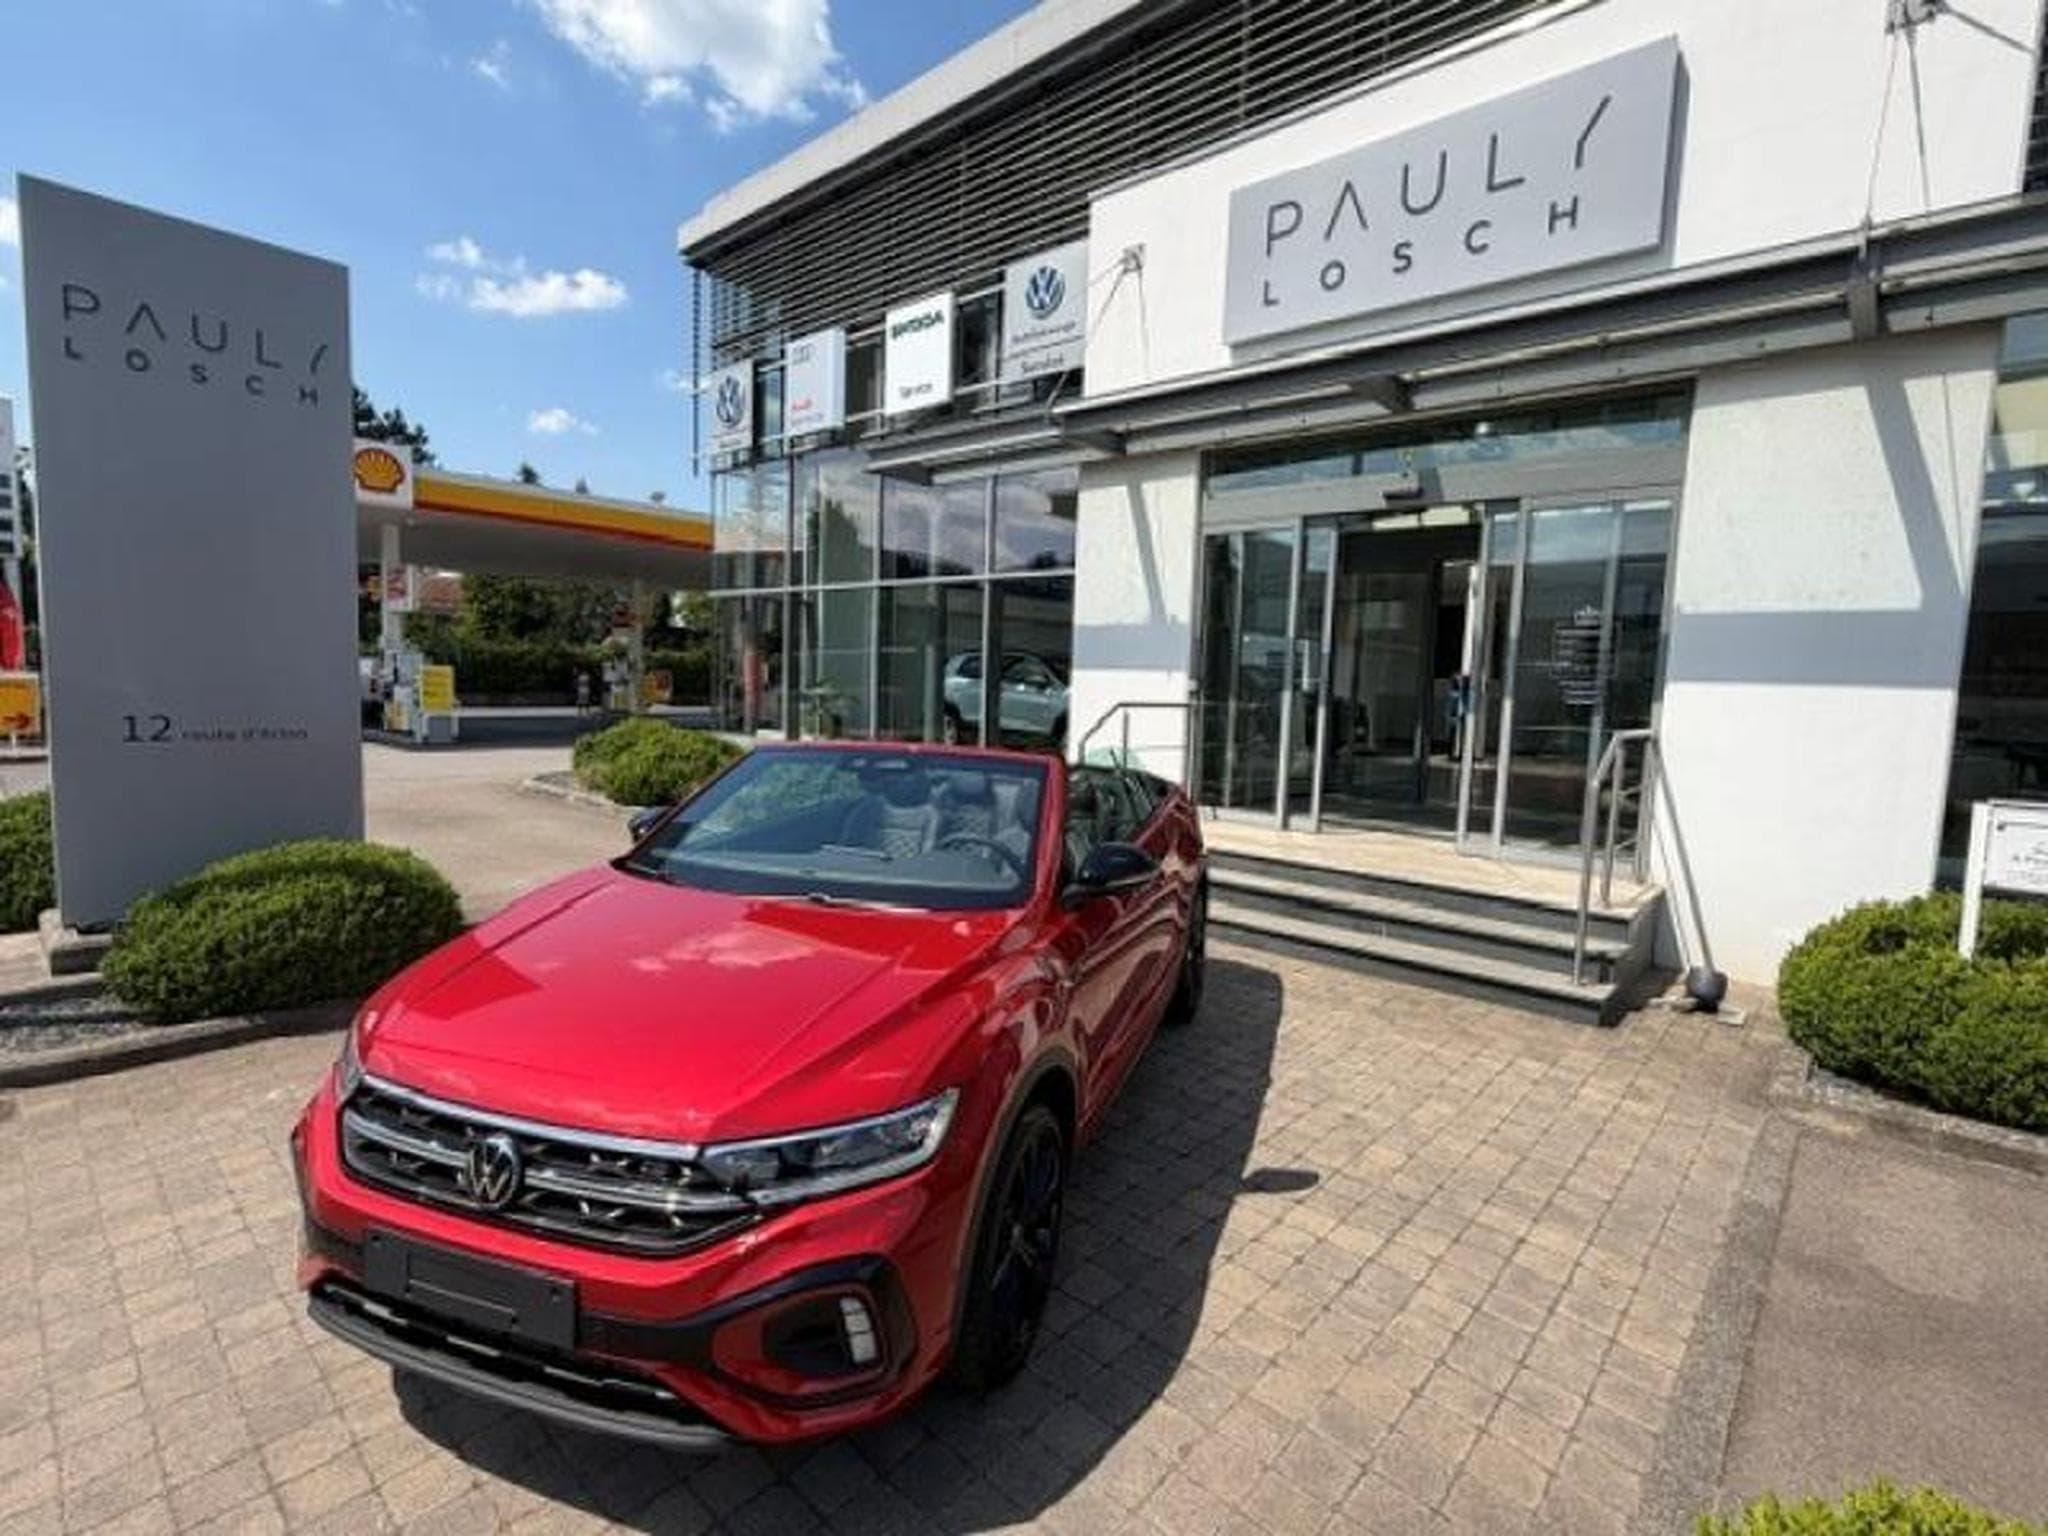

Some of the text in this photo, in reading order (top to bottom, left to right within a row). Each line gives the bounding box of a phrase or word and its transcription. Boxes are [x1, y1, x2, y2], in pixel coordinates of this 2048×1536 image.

[1266, 95, 1612, 257] PAULY
[1263, 196, 1579, 306] LOSCH
[62, 283, 328, 374] PAULY
[65, 336, 318, 404] LOSCH
[122, 714, 176, 743] 12
